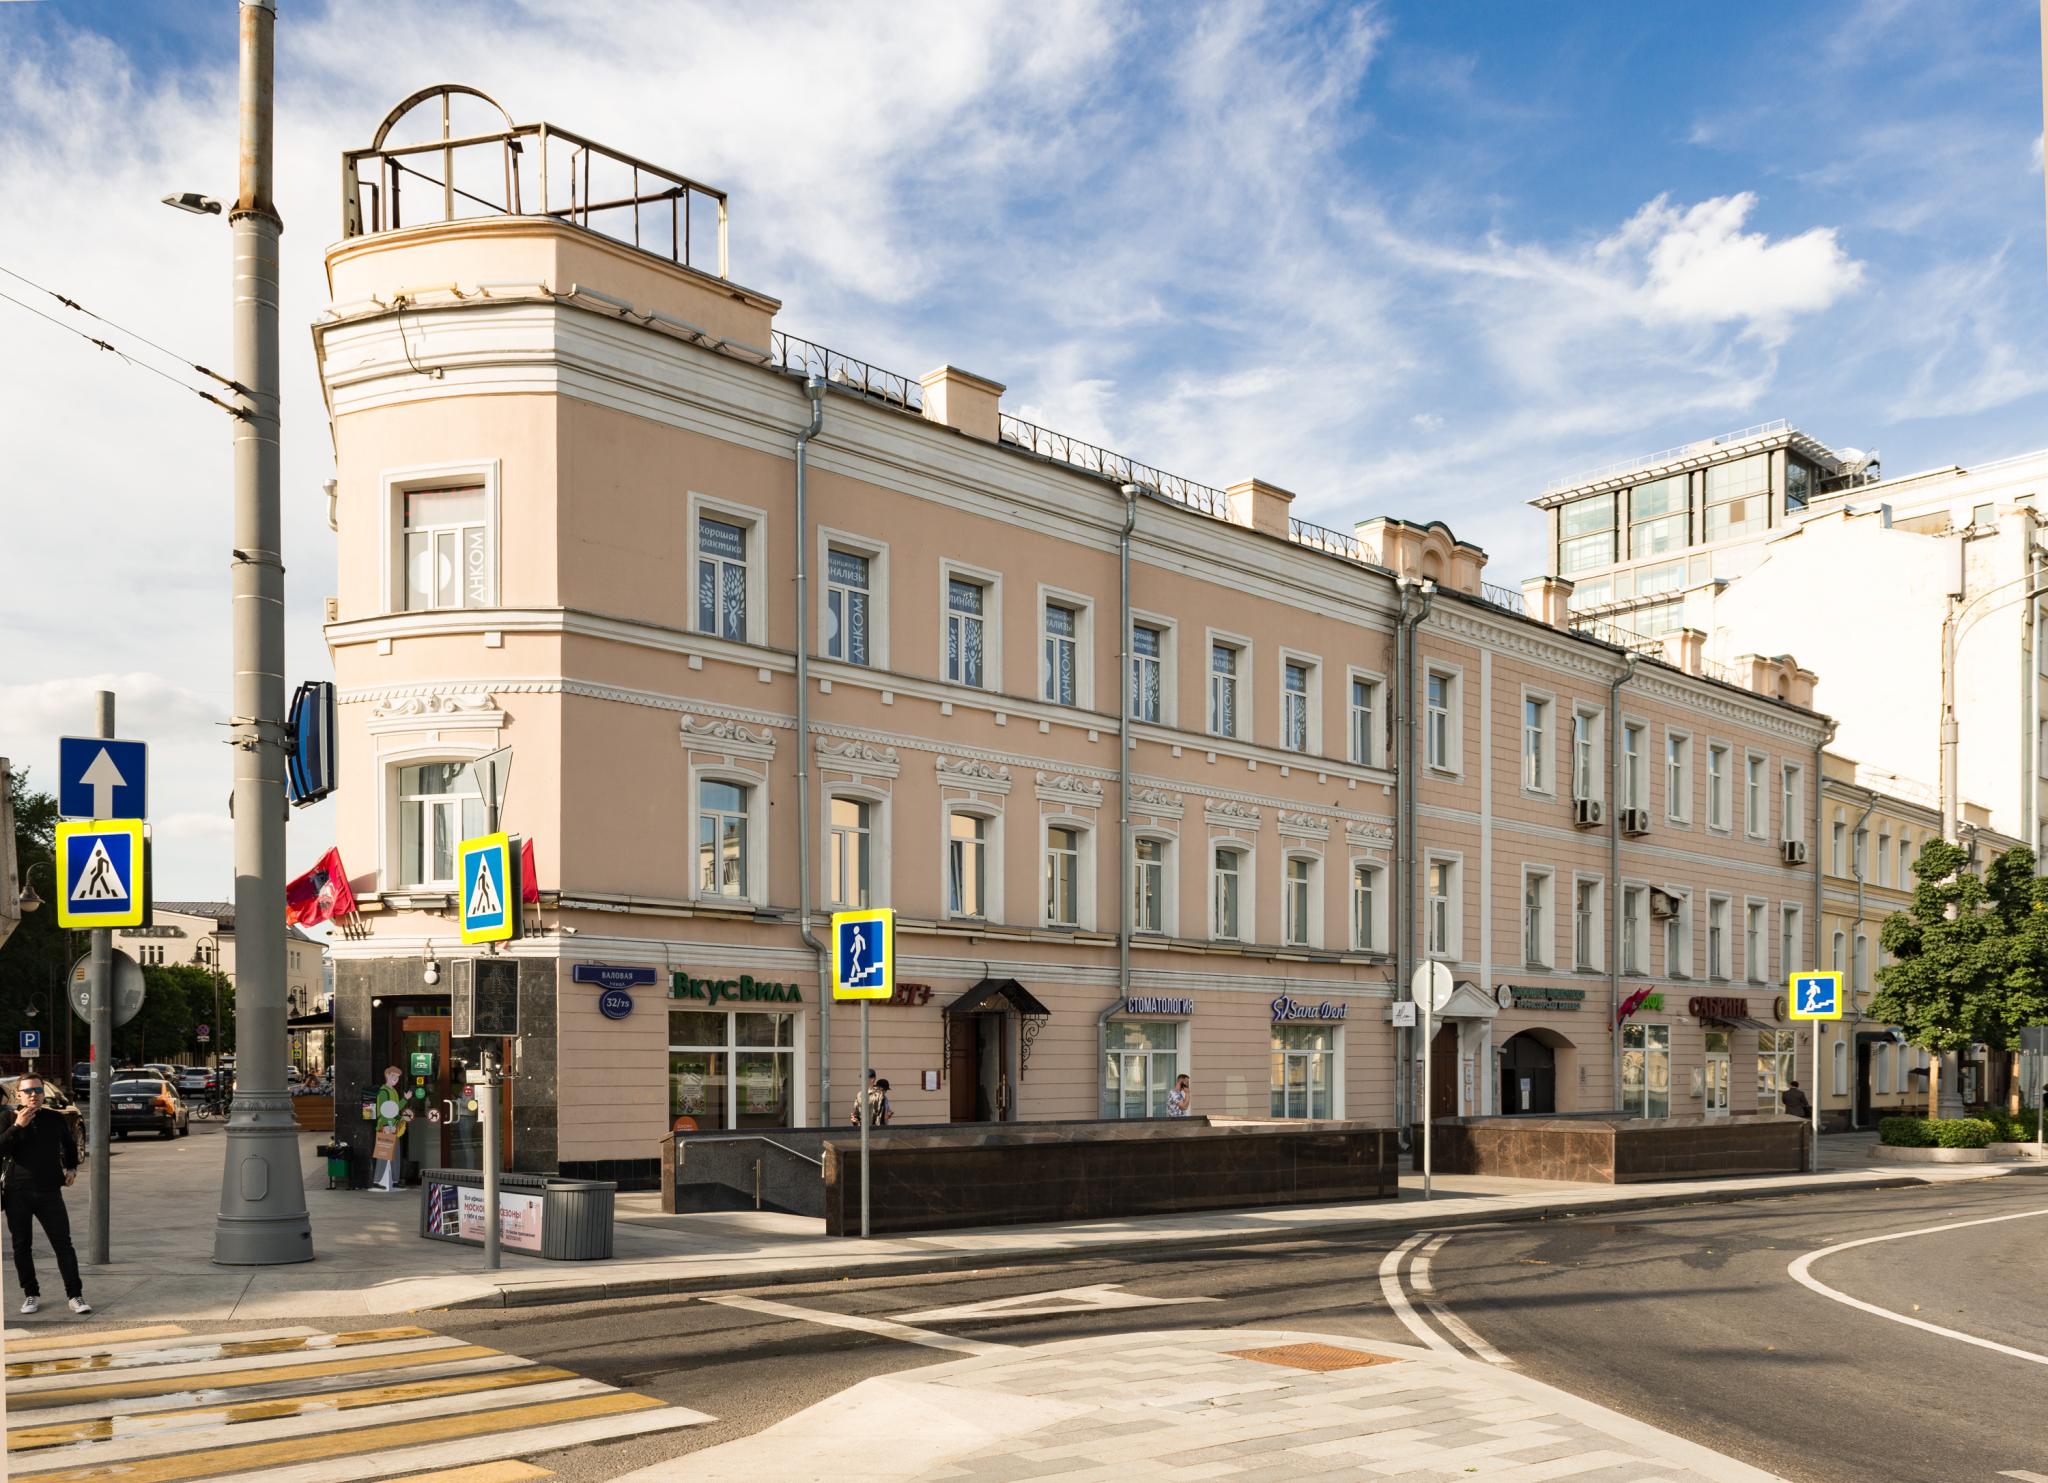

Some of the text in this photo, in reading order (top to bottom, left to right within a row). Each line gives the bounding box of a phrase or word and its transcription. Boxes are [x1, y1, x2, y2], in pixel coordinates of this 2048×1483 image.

[700, 538, 742, 553] рактика
[829, 567, 866, 583] НАЛИЗЫ
[602, 971, 633, 980] ВАЛОВАЯ
[606, 997, 630, 1009] 32/75
[1127, 996, 1194, 1015] СТОМАТОЛОГИЯ
[1288, 1000, 1348, 1019] Sana Dent
[1640, 993, 1664, 1011] АФЕ
[1689, 996, 1748, 1017] САБРИНА
